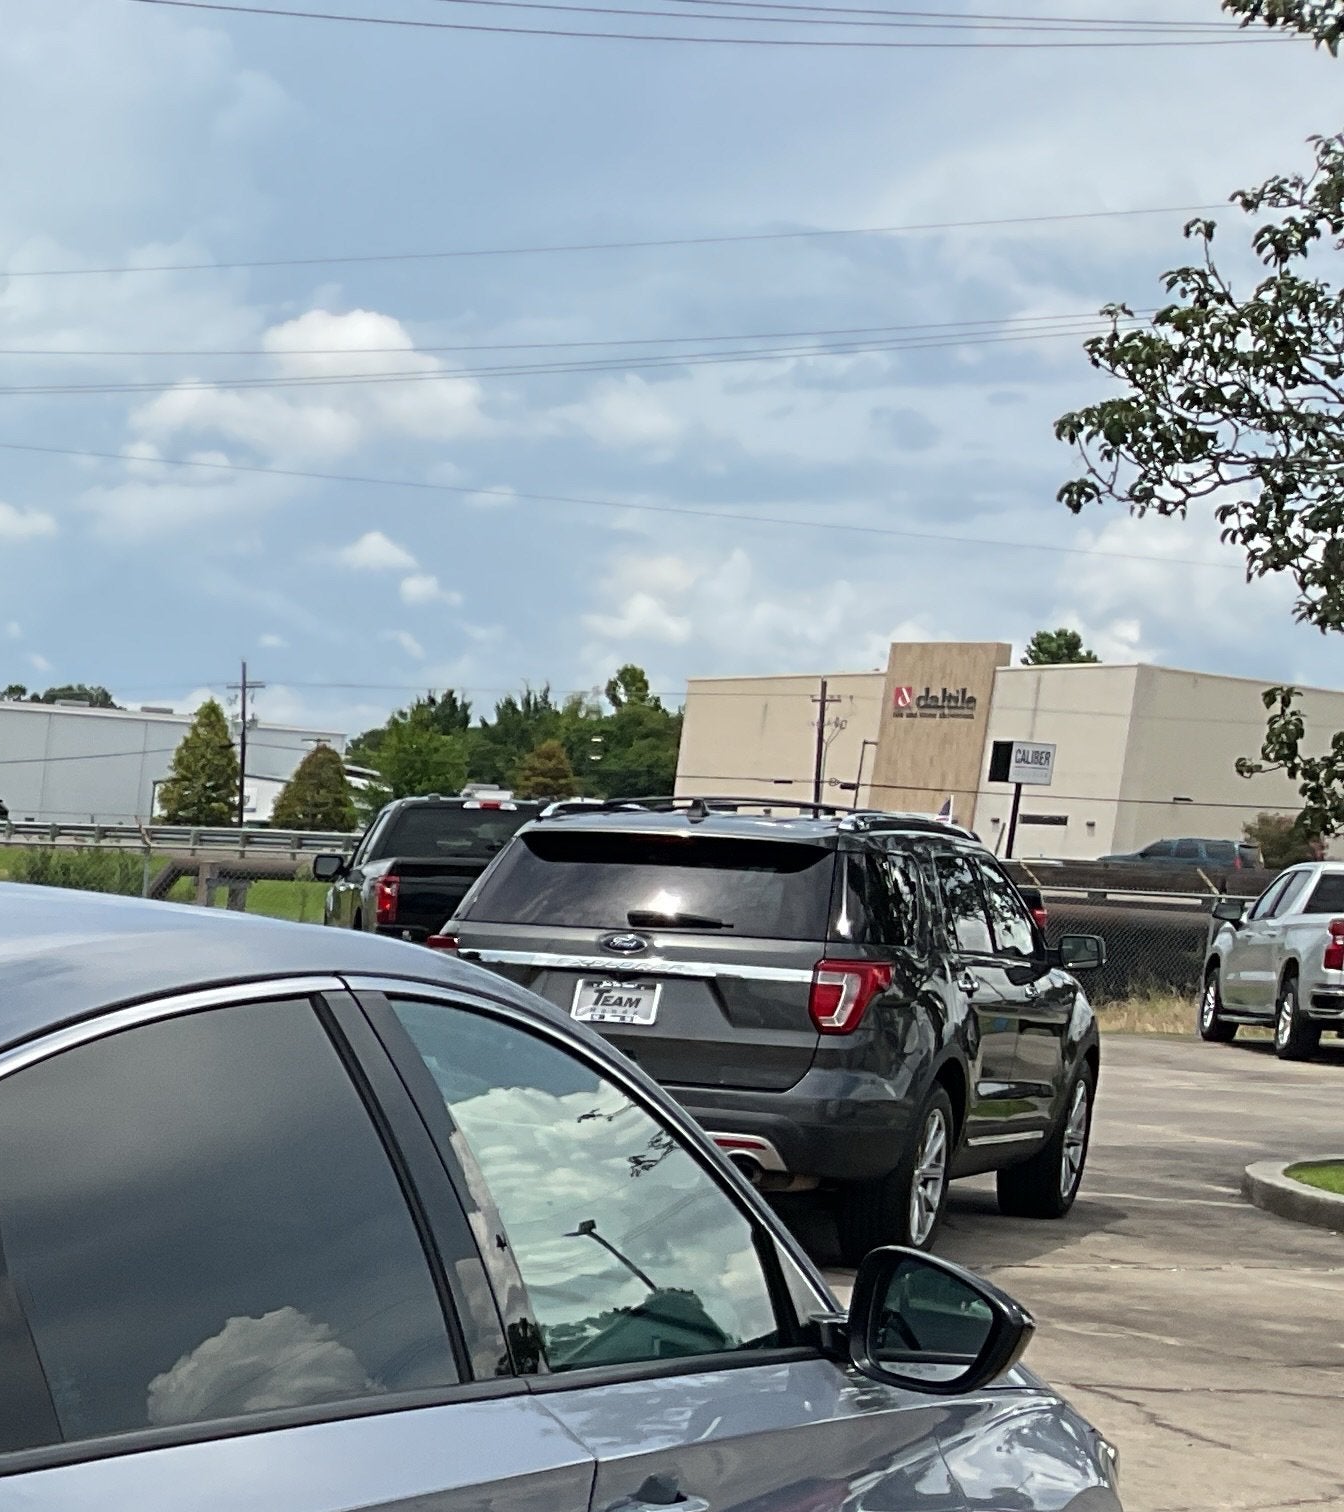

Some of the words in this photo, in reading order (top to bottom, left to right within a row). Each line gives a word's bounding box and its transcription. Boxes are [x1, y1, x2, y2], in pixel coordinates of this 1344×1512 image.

[1015, 749, 1051, 766] CALIBER
[610, 934, 637, 948] Ford
[592, 988, 642, 1009] TEAM
